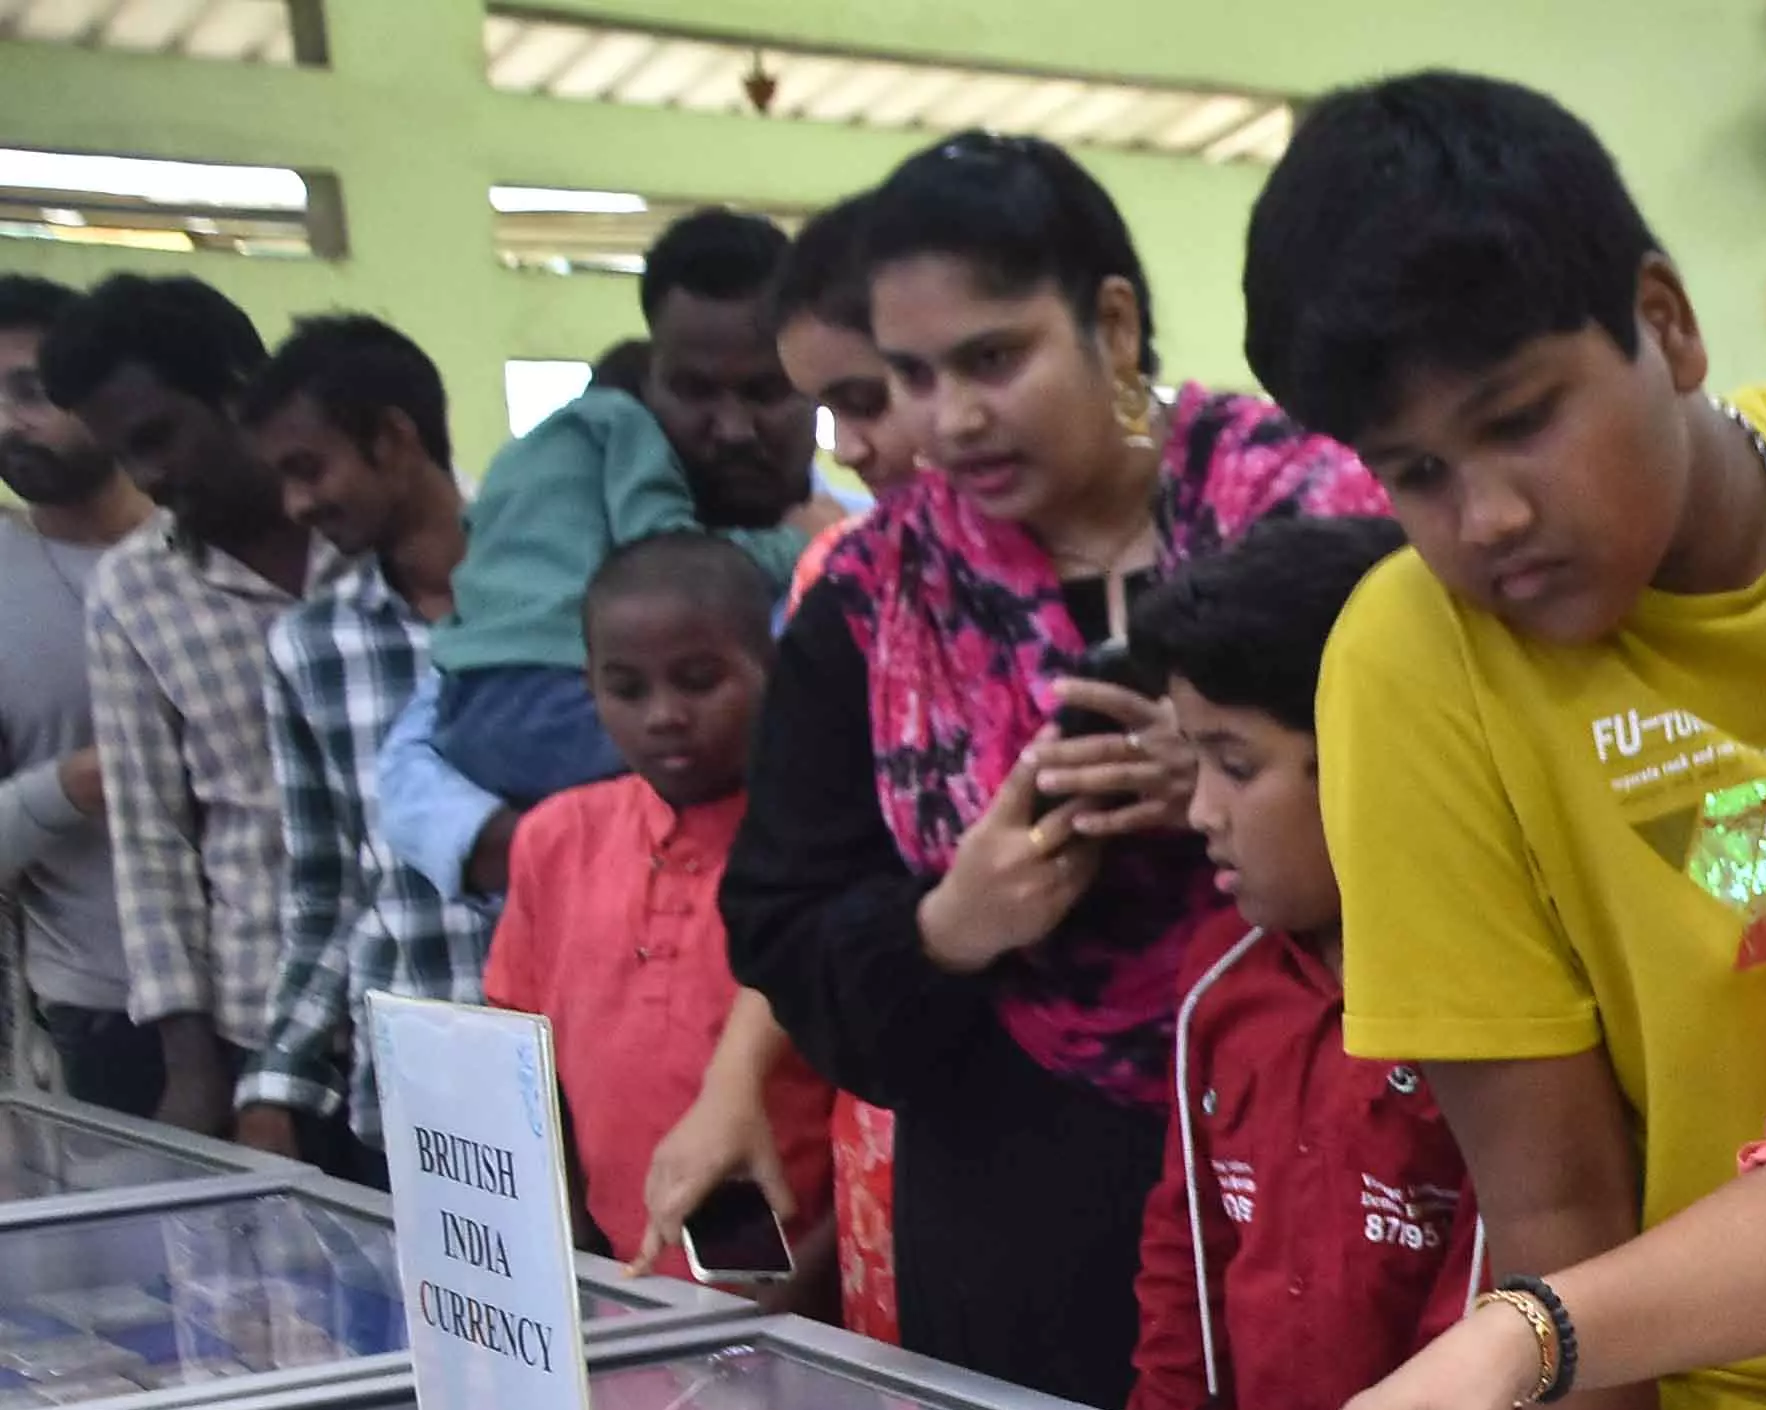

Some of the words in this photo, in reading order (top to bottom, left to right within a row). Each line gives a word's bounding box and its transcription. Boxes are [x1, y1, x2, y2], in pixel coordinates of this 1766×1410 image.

[415, 1126, 519, 1200] BRITISH
[440, 1210, 513, 1279] INDIA
[420, 1280, 554, 1374] CURRENCY
